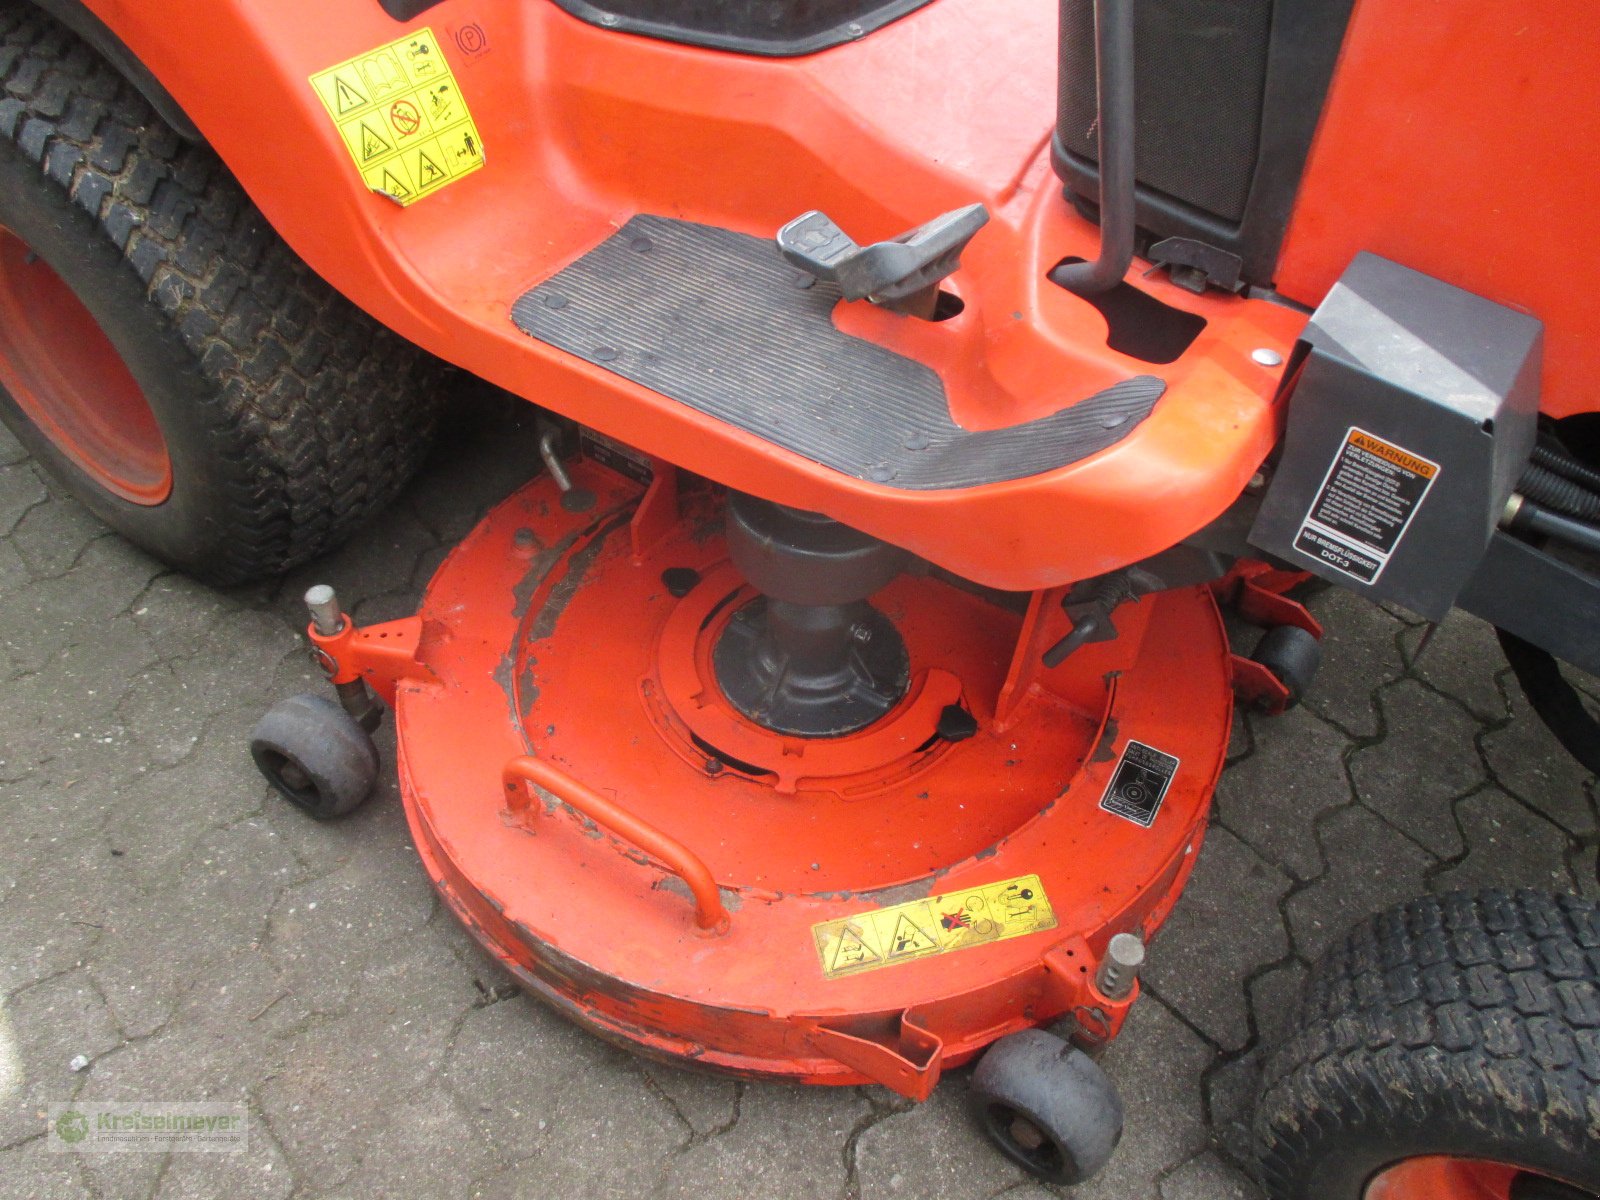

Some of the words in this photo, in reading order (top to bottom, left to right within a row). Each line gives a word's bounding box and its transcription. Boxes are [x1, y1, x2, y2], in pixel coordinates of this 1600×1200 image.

[1347, 445, 1361, 455] ZUR
[1361, 451, 1402, 473] VERMEIDUNG
[1401, 469, 1417, 480] VON
[1365, 440, 1431, 475] WARNUNG
[1303, 531, 1318, 542] NUR
[1317, 536, 1377, 571] BREMSFLÜSSIGKEIT
[1321, 550, 1350, 568] DOT-3
